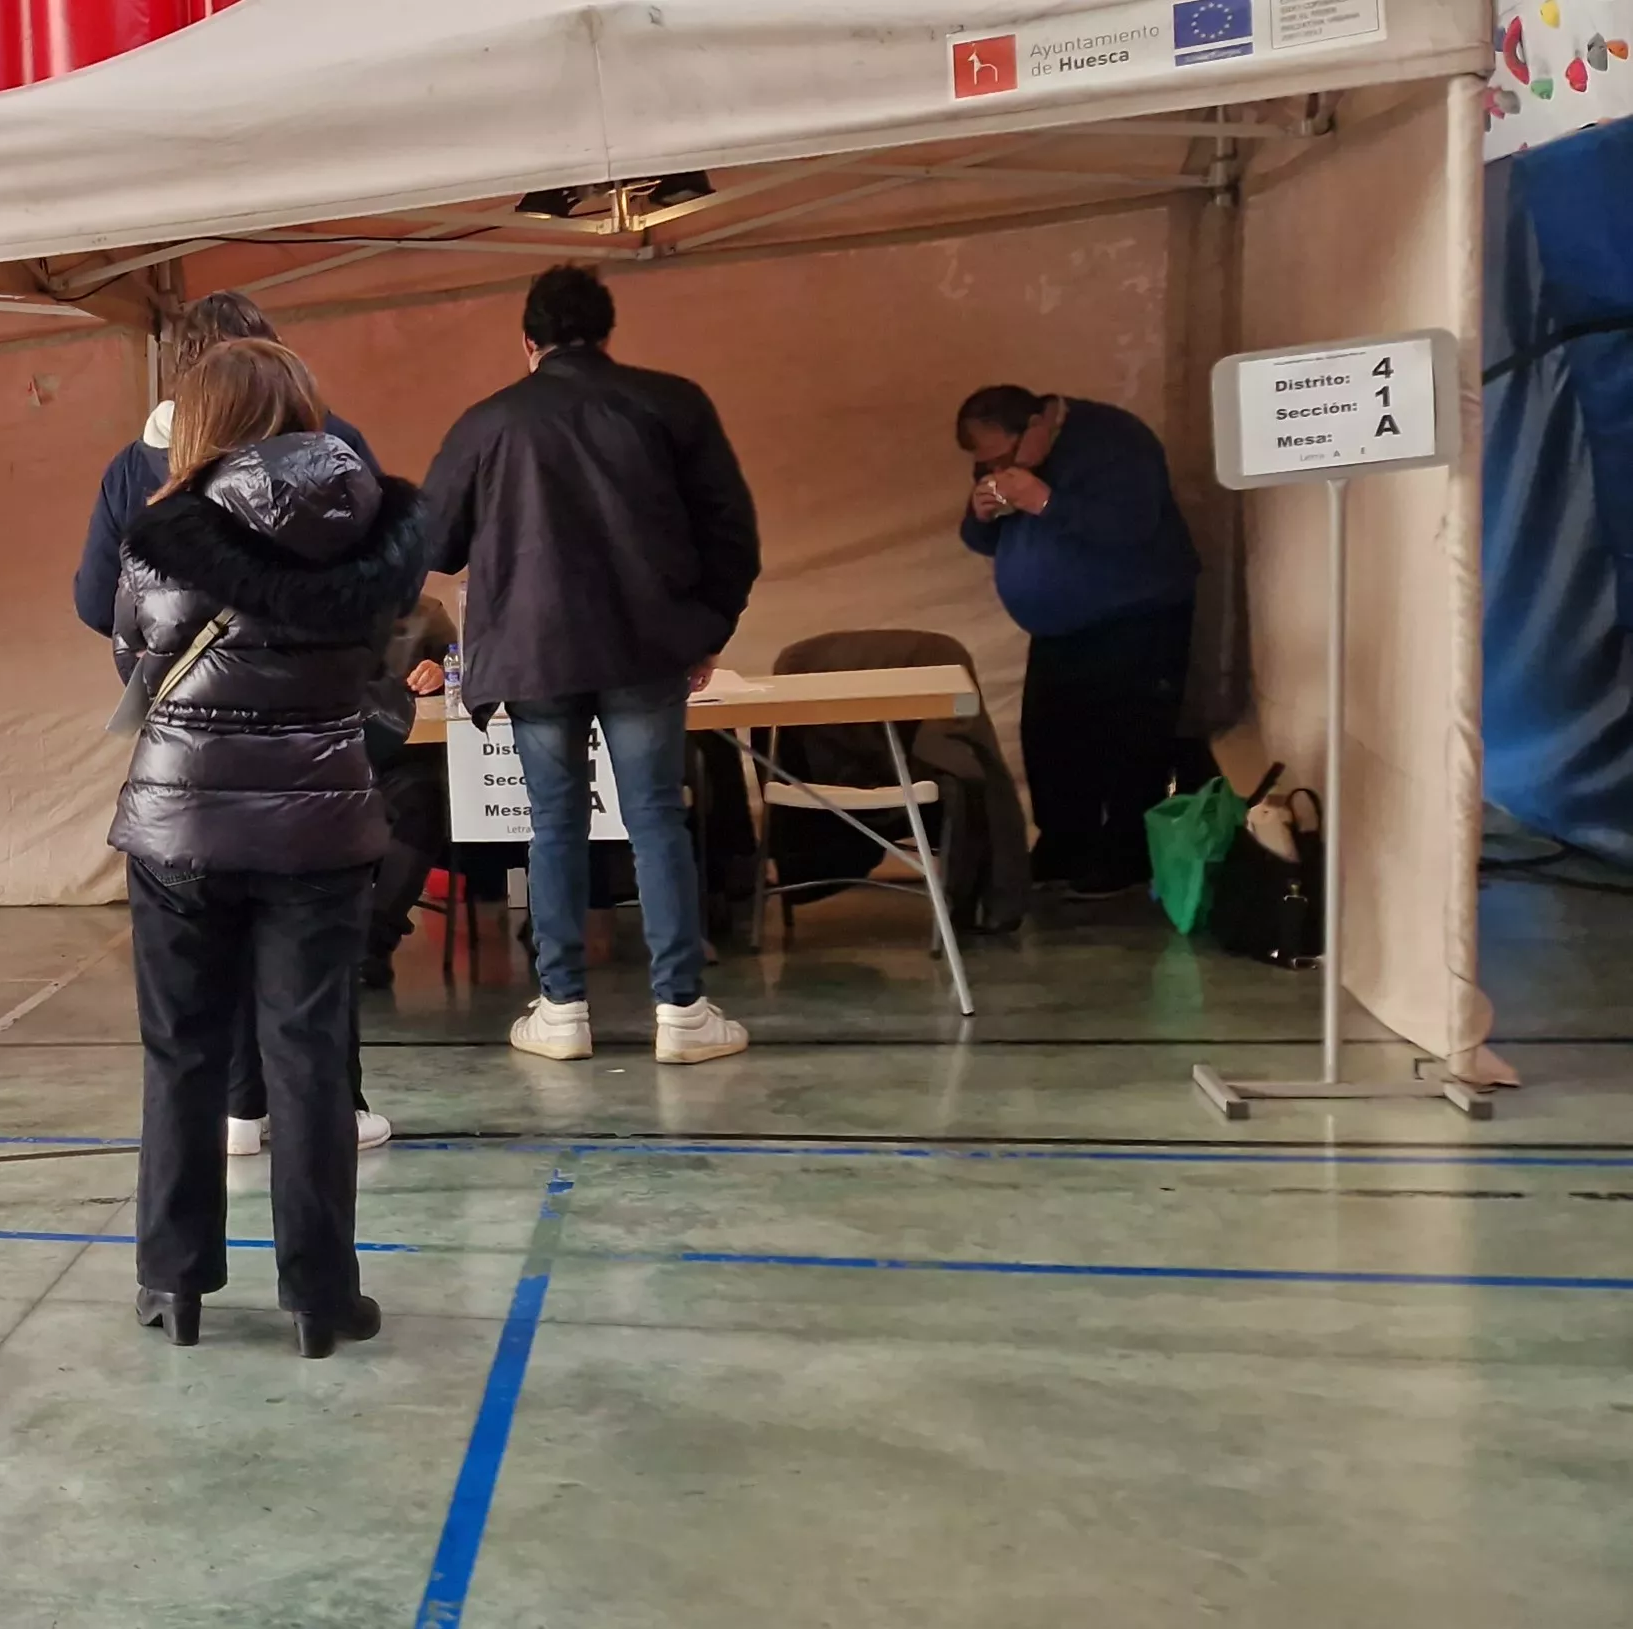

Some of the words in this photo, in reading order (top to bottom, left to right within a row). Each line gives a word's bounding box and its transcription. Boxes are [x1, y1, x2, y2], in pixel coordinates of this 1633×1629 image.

[1030, 25, 1160, 60] Ayuntamiento
[1031, 62, 1052, 78] de
[1059, 49, 1130, 72] Huesca
[1275, 373, 1351, 393] Distrito:
[1371, 357, 1395, 379] 4
[1276, 401, 1358, 420] Sección:
[1375, 385, 1391, 408] 1
[1277, 432, 1333, 448] Mesa:
[1374, 414, 1401, 437] A
[485, 804, 532, 817] Mesa
